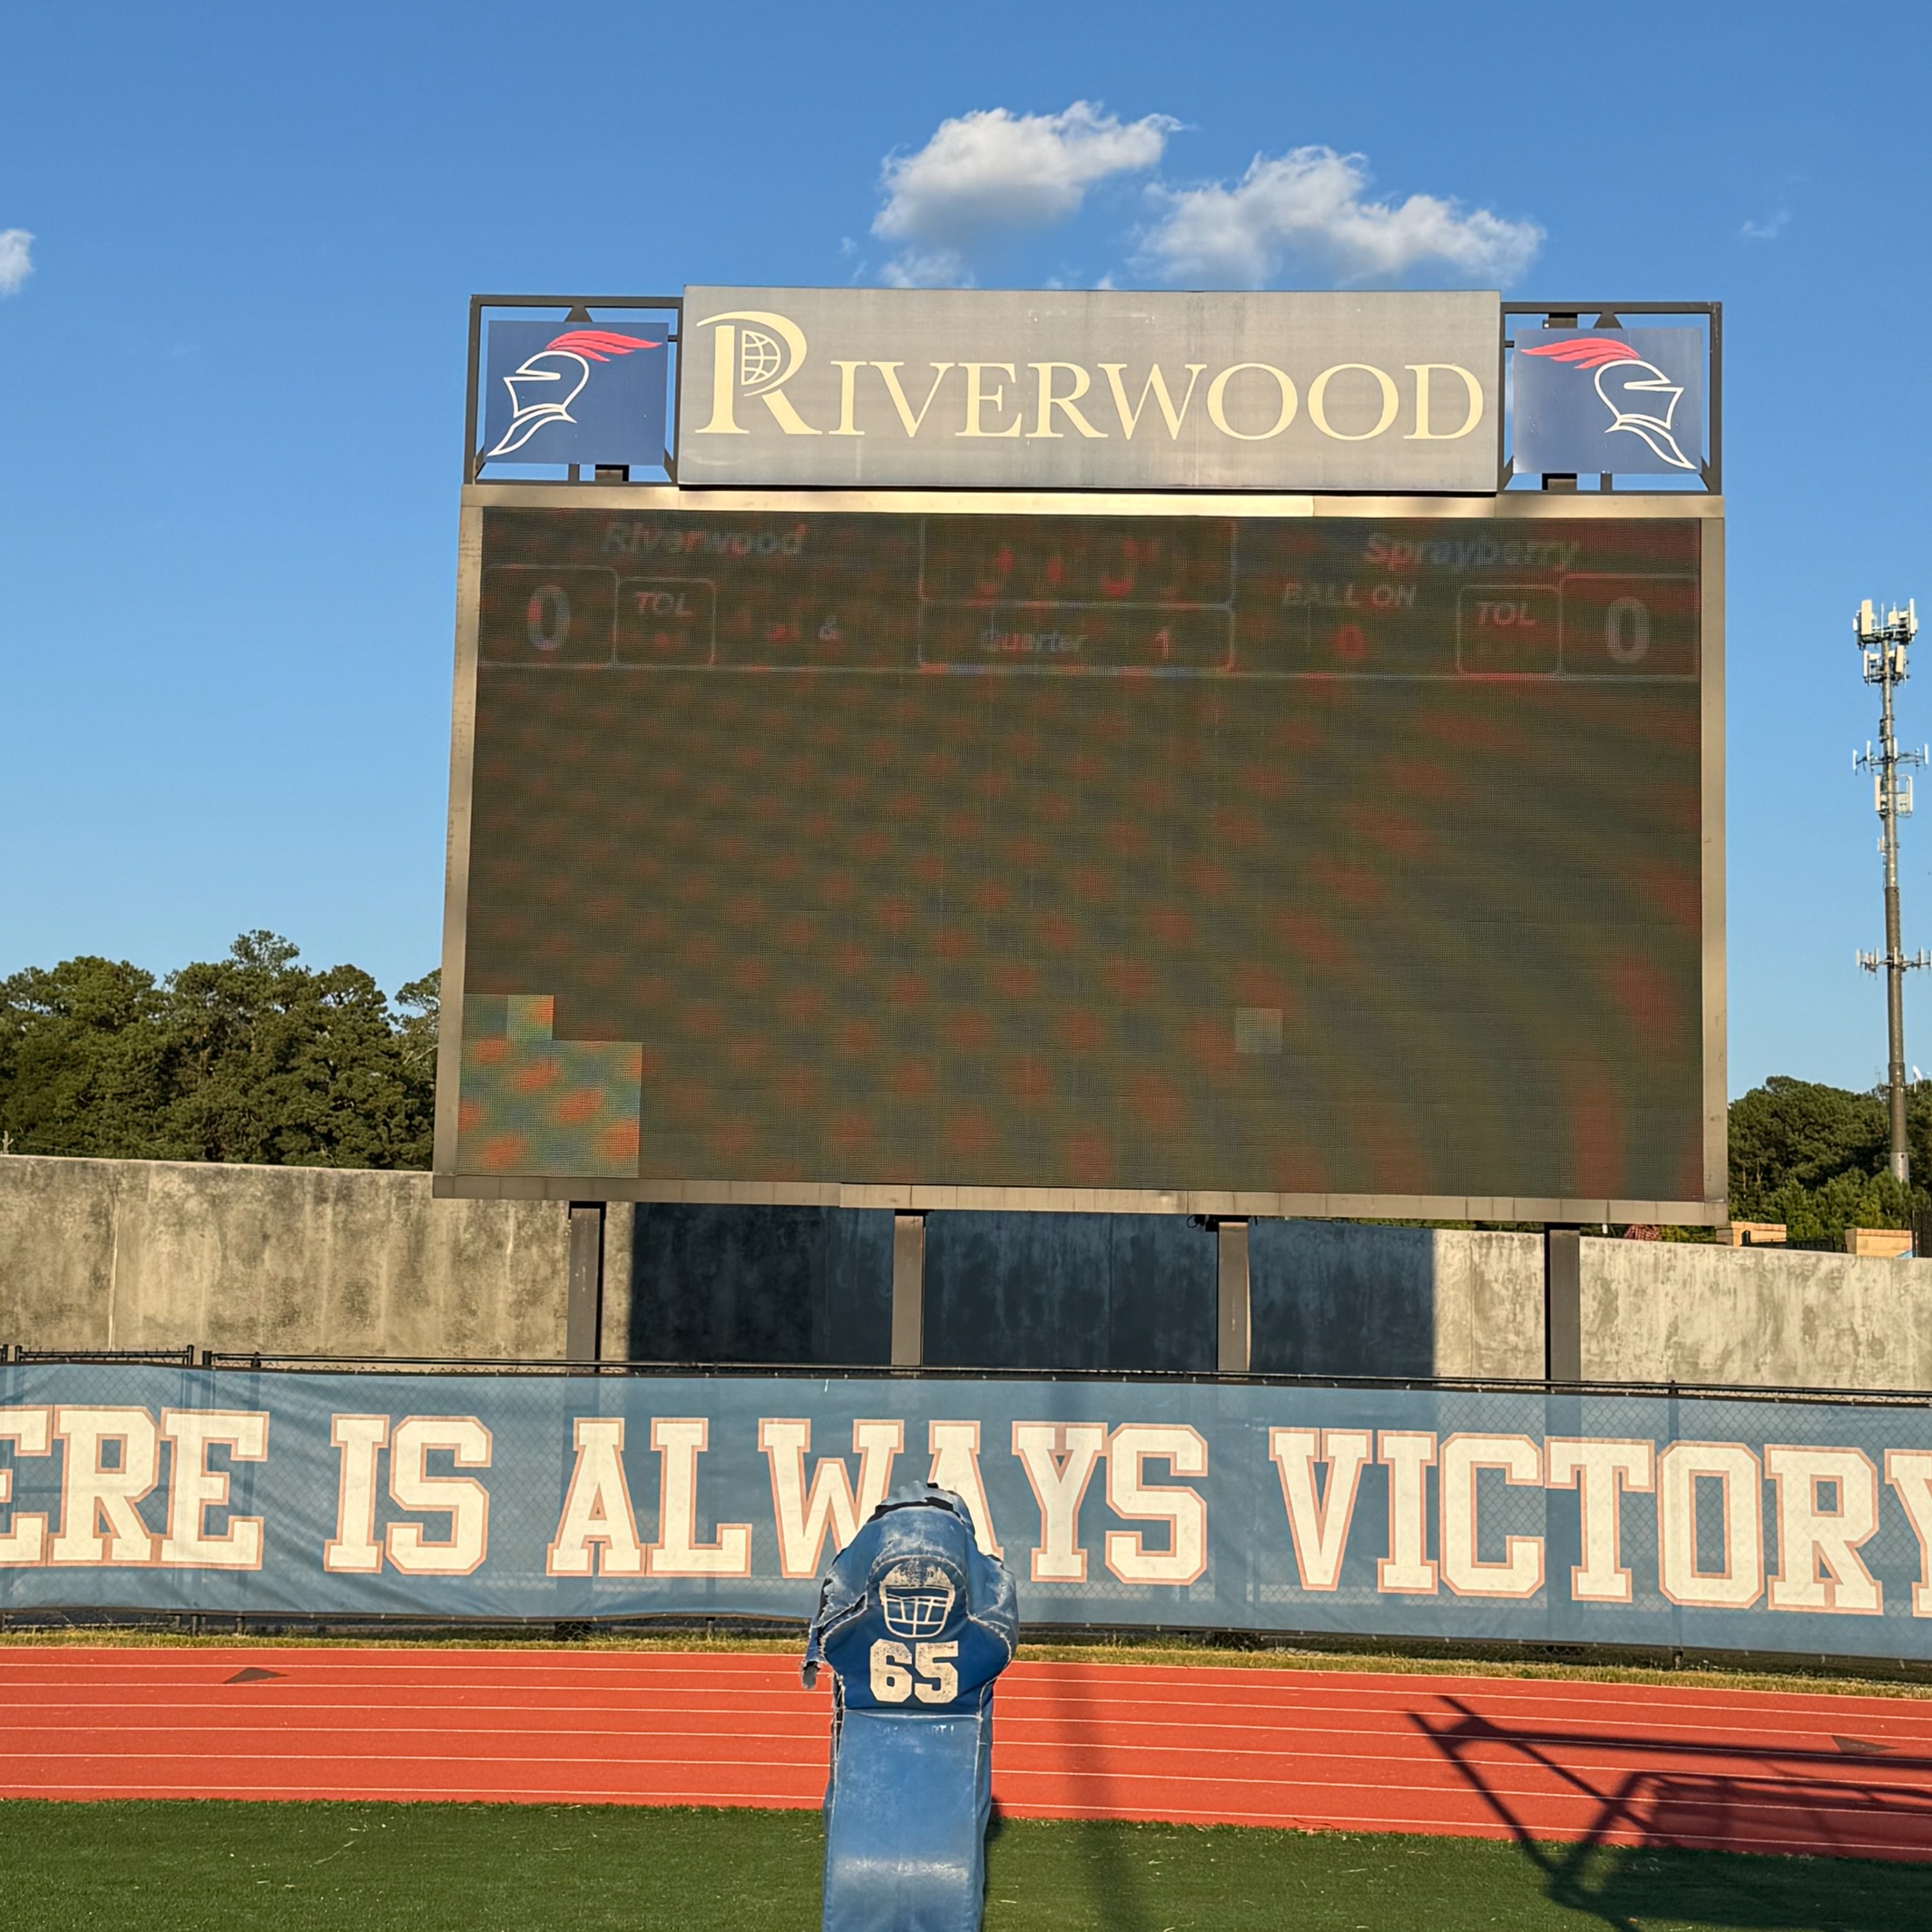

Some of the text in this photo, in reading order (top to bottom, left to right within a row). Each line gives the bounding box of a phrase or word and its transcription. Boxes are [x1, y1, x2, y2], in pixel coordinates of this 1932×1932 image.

[695, 310, 1484, 441] RIVERWOOD
[601, 522, 809, 555] Riverwood
[1363, 532, 1580, 571] Sprayberry
[526, 584, 572, 652] 0
[635, 591, 694, 618] TOL
[1282, 582, 1417, 609] BALL ON
[1475, 601, 1537, 628] TOL
[1604, 596, 1651, 665] 0
[323, 1414, 492, 1575] IS
[870, 1638, 959, 1704] 65
